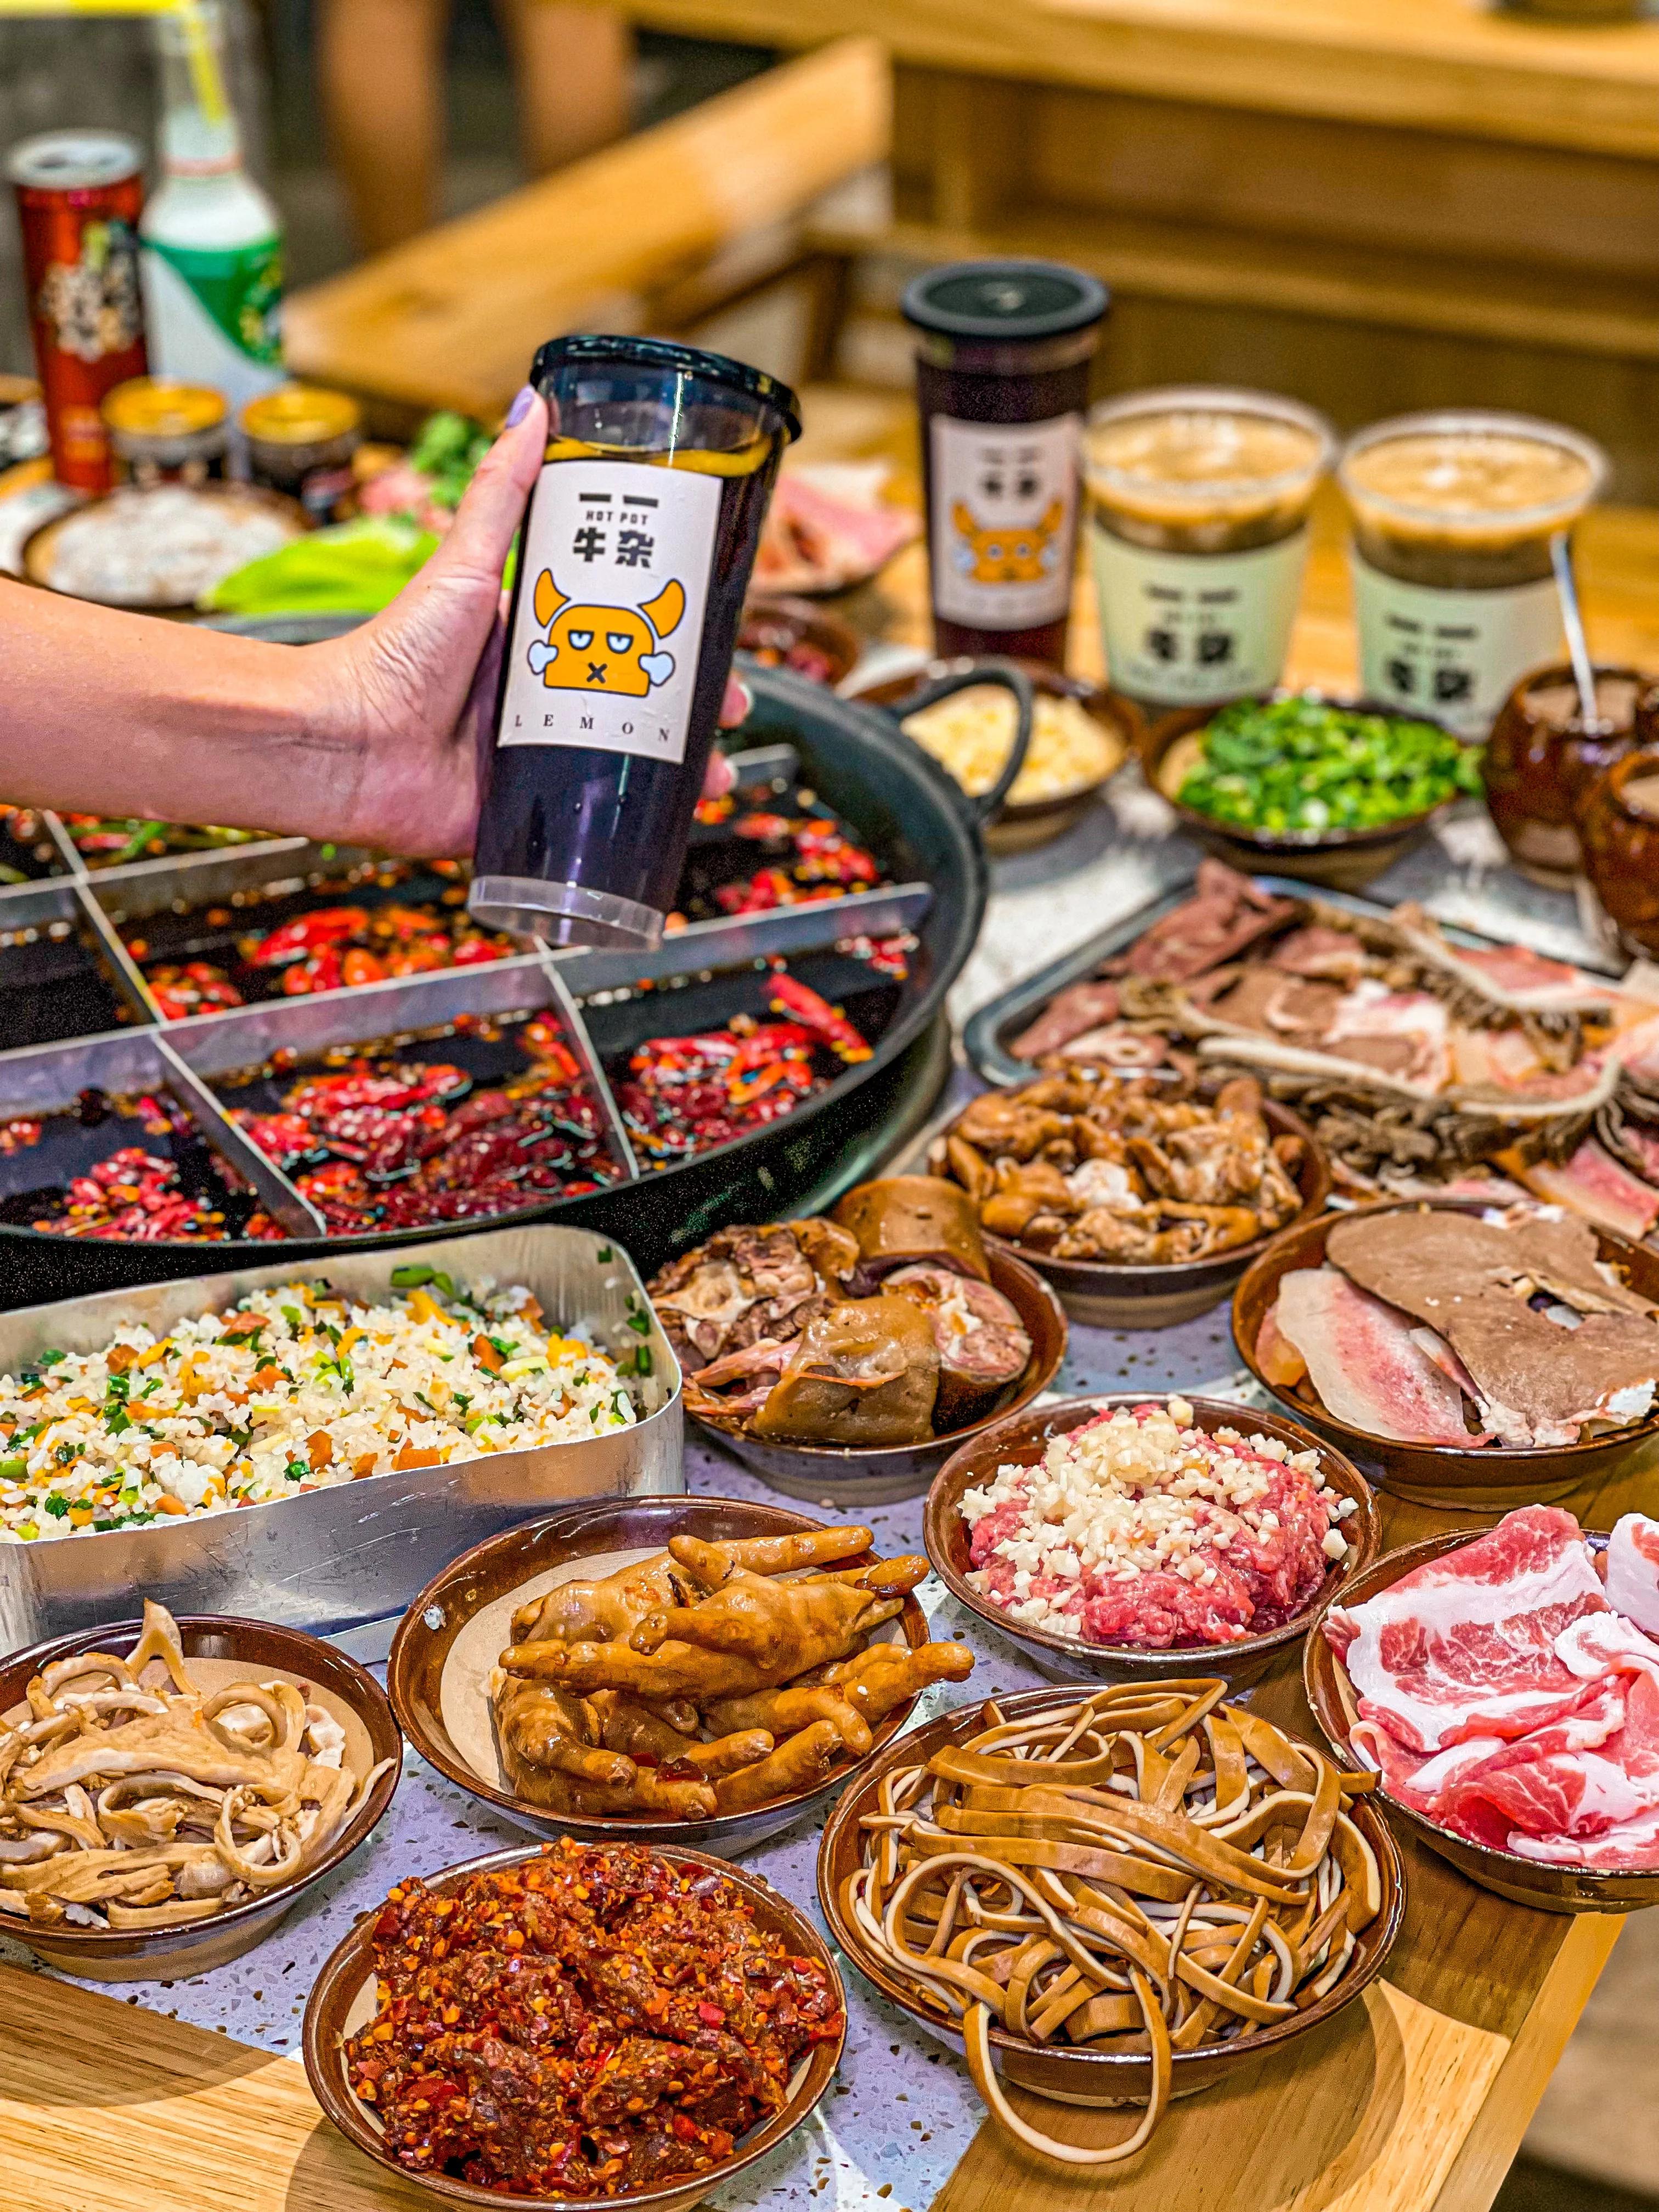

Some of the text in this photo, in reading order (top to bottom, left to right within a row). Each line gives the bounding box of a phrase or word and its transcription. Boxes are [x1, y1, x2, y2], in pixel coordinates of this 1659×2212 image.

[586, 510, 648, 525] HOT POT
[573, 526, 654, 568] 牛杂
[514, 714, 670, 742] LEMON
